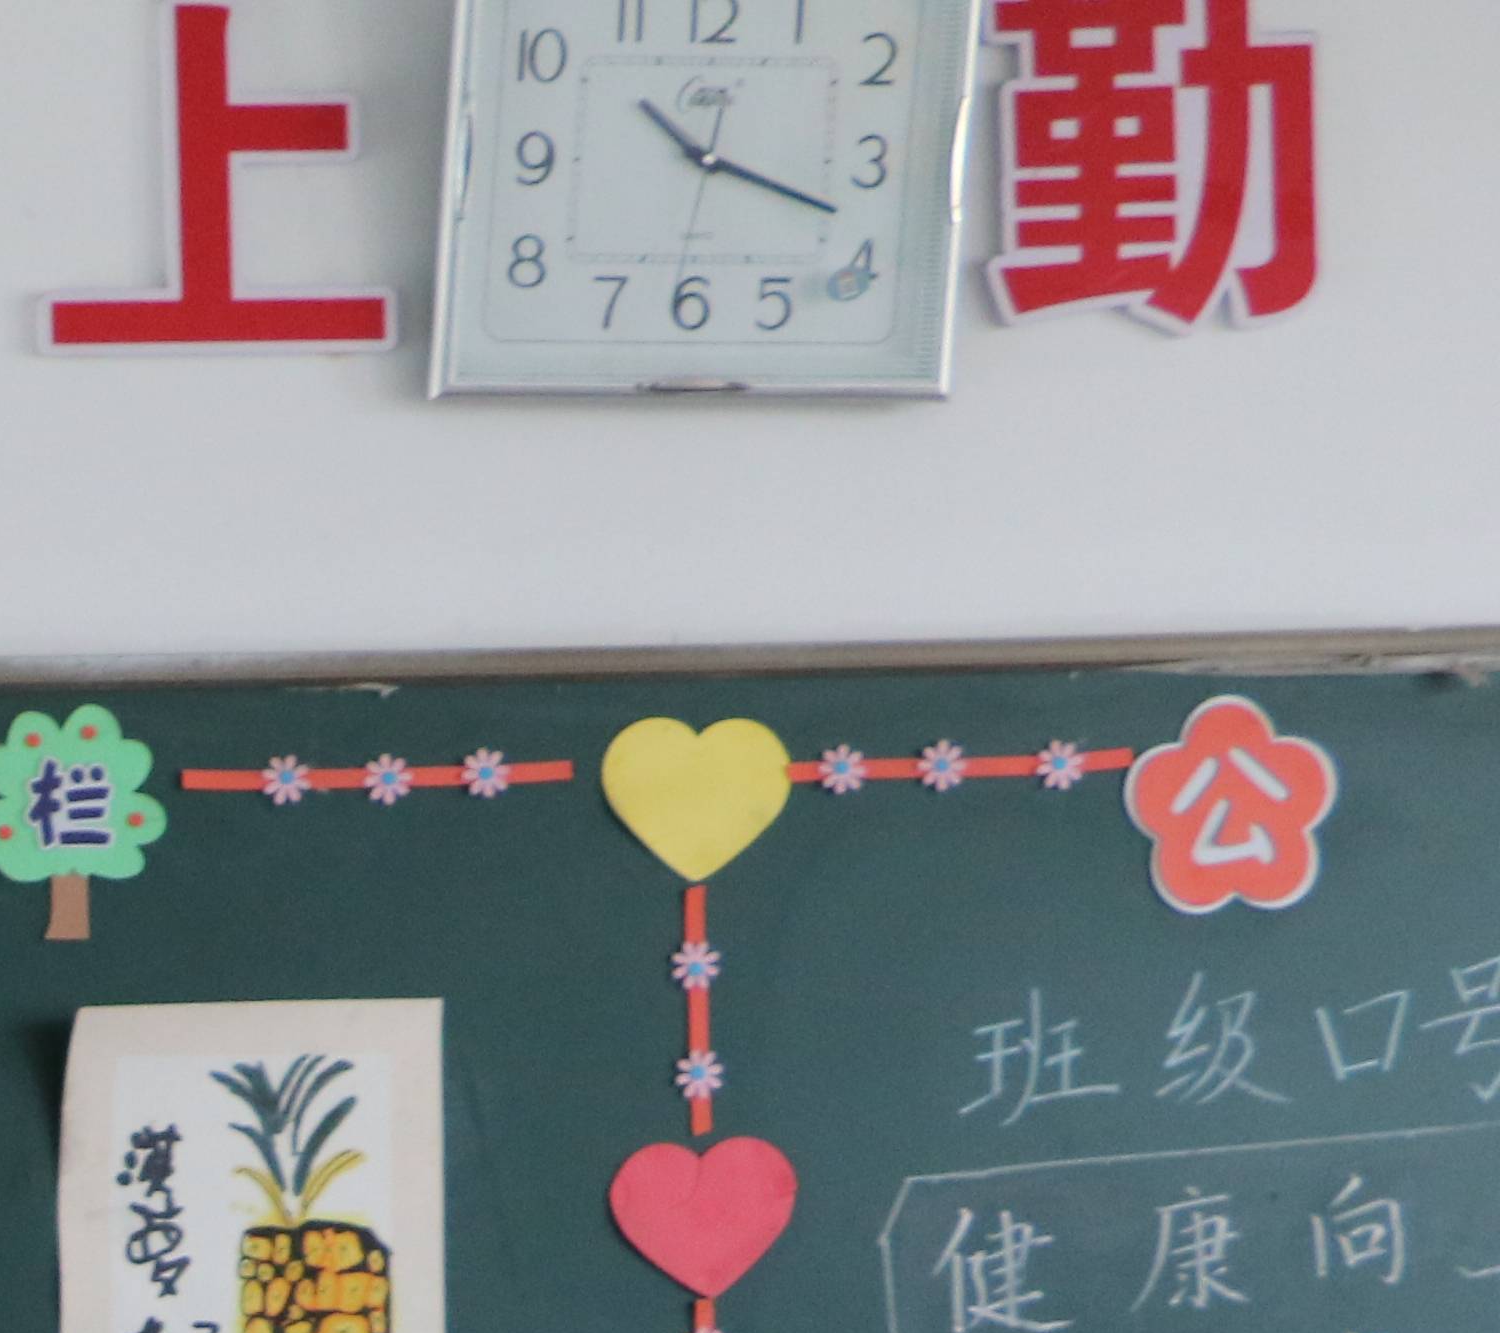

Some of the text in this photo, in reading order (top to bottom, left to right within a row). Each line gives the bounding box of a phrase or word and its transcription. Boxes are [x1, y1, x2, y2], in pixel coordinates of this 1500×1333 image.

[690, 0, 737, 43] 12
[517, 28, 567, 82] 10
[860, 33, 898, 85] 2
[515, 131, 556, 186] 9
[851, 134, 889, 188] 3
[997, 0, 1314, 319] 勤
[507, 235, 547, 288] 8
[595, 277, 629, 329] 7
[671, 277, 712, 330] 6
[755, 278, 793, 330] 5
[1171, 746, 1290, 864] 公
